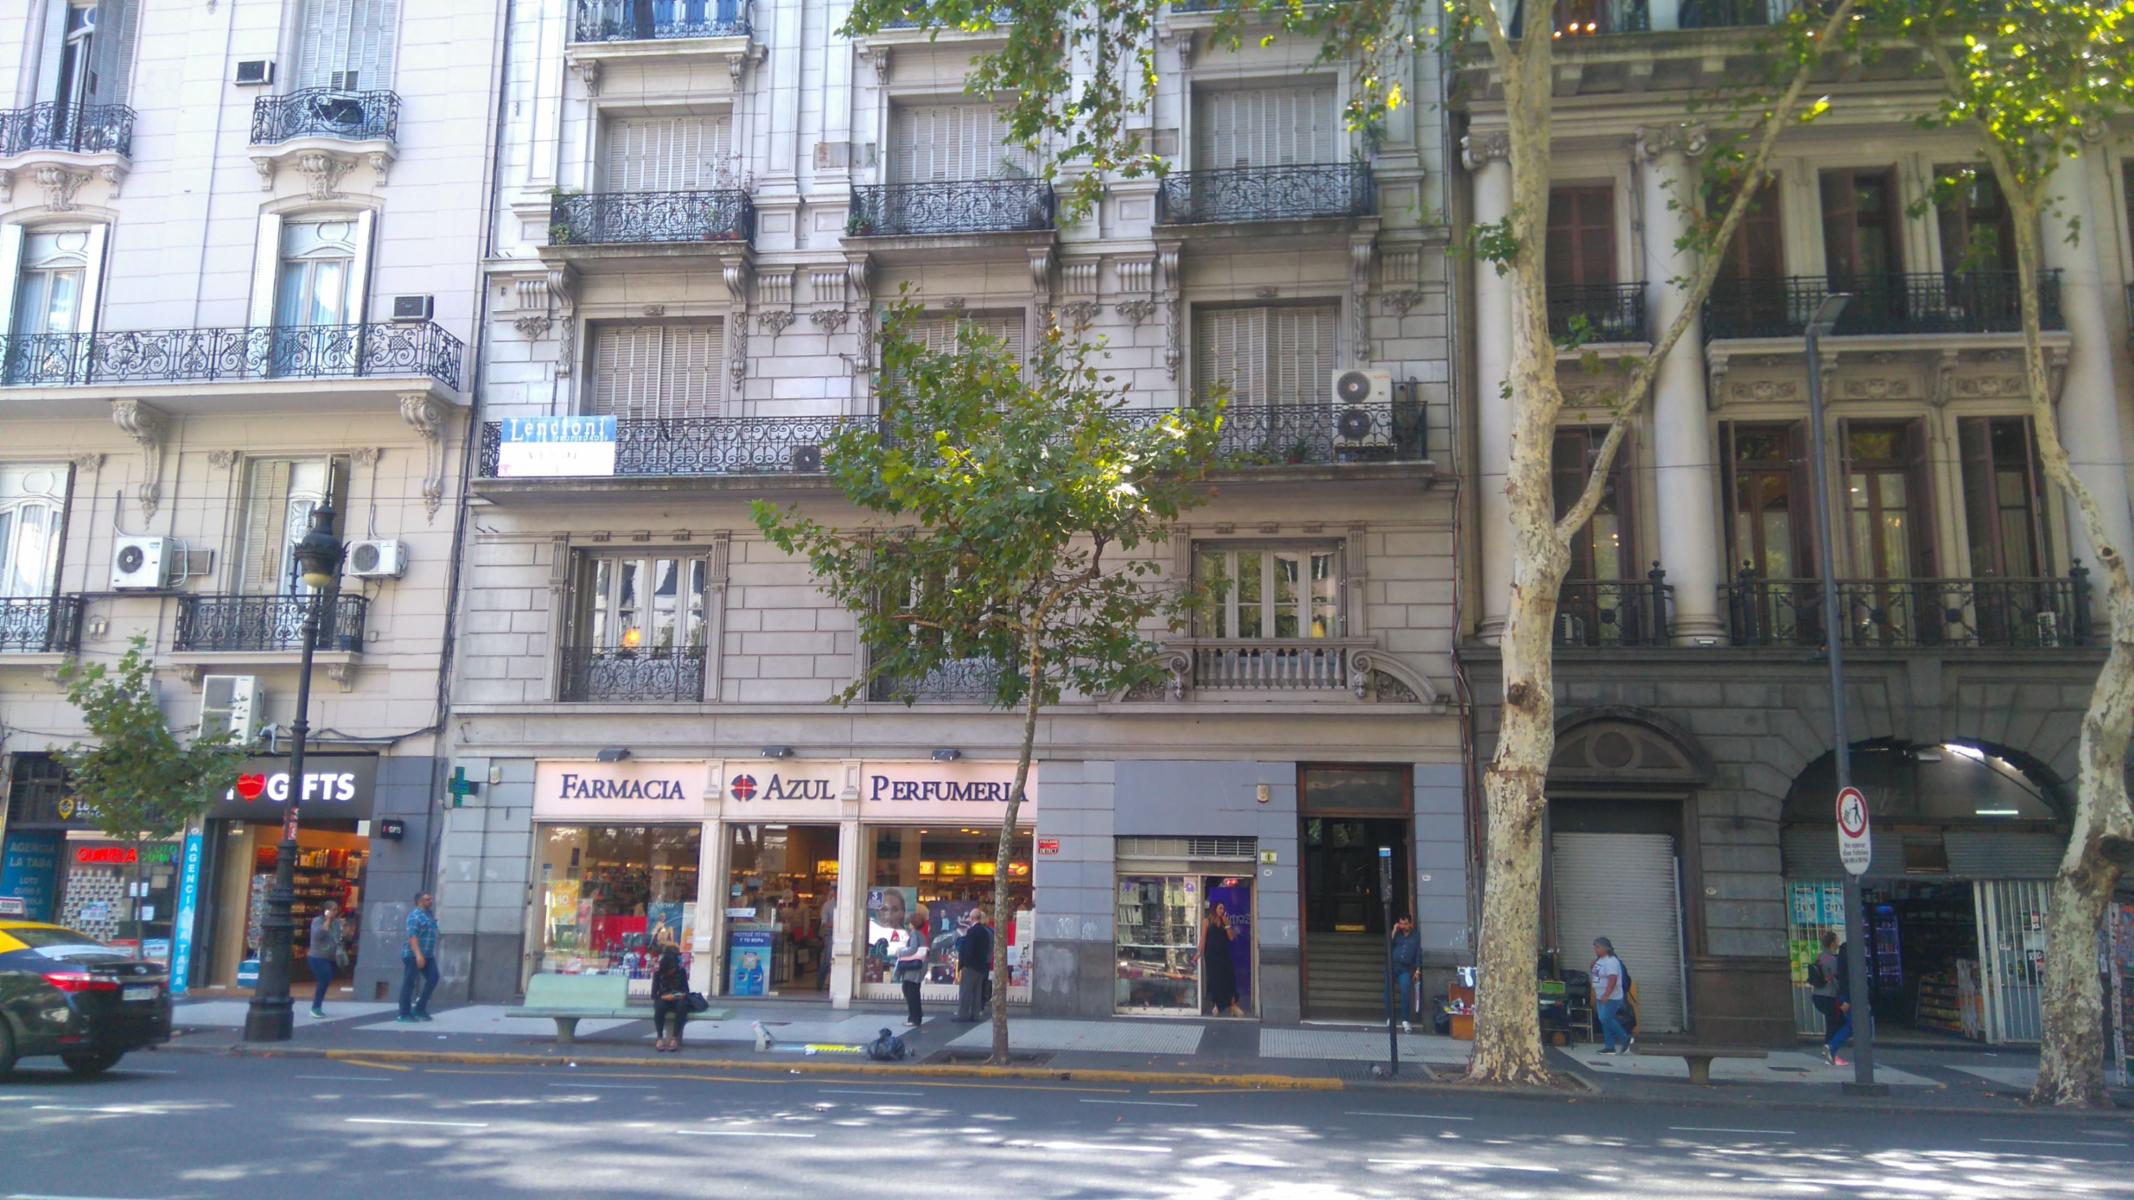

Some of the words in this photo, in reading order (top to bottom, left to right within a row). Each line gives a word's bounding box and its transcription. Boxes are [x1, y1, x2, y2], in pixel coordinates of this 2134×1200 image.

[510, 417, 606, 441] Lencioni
[267, 773, 355, 801] GFTS
[560, 774, 685, 800] FARMACIA
[762, 773, 835, 800] AZUL
